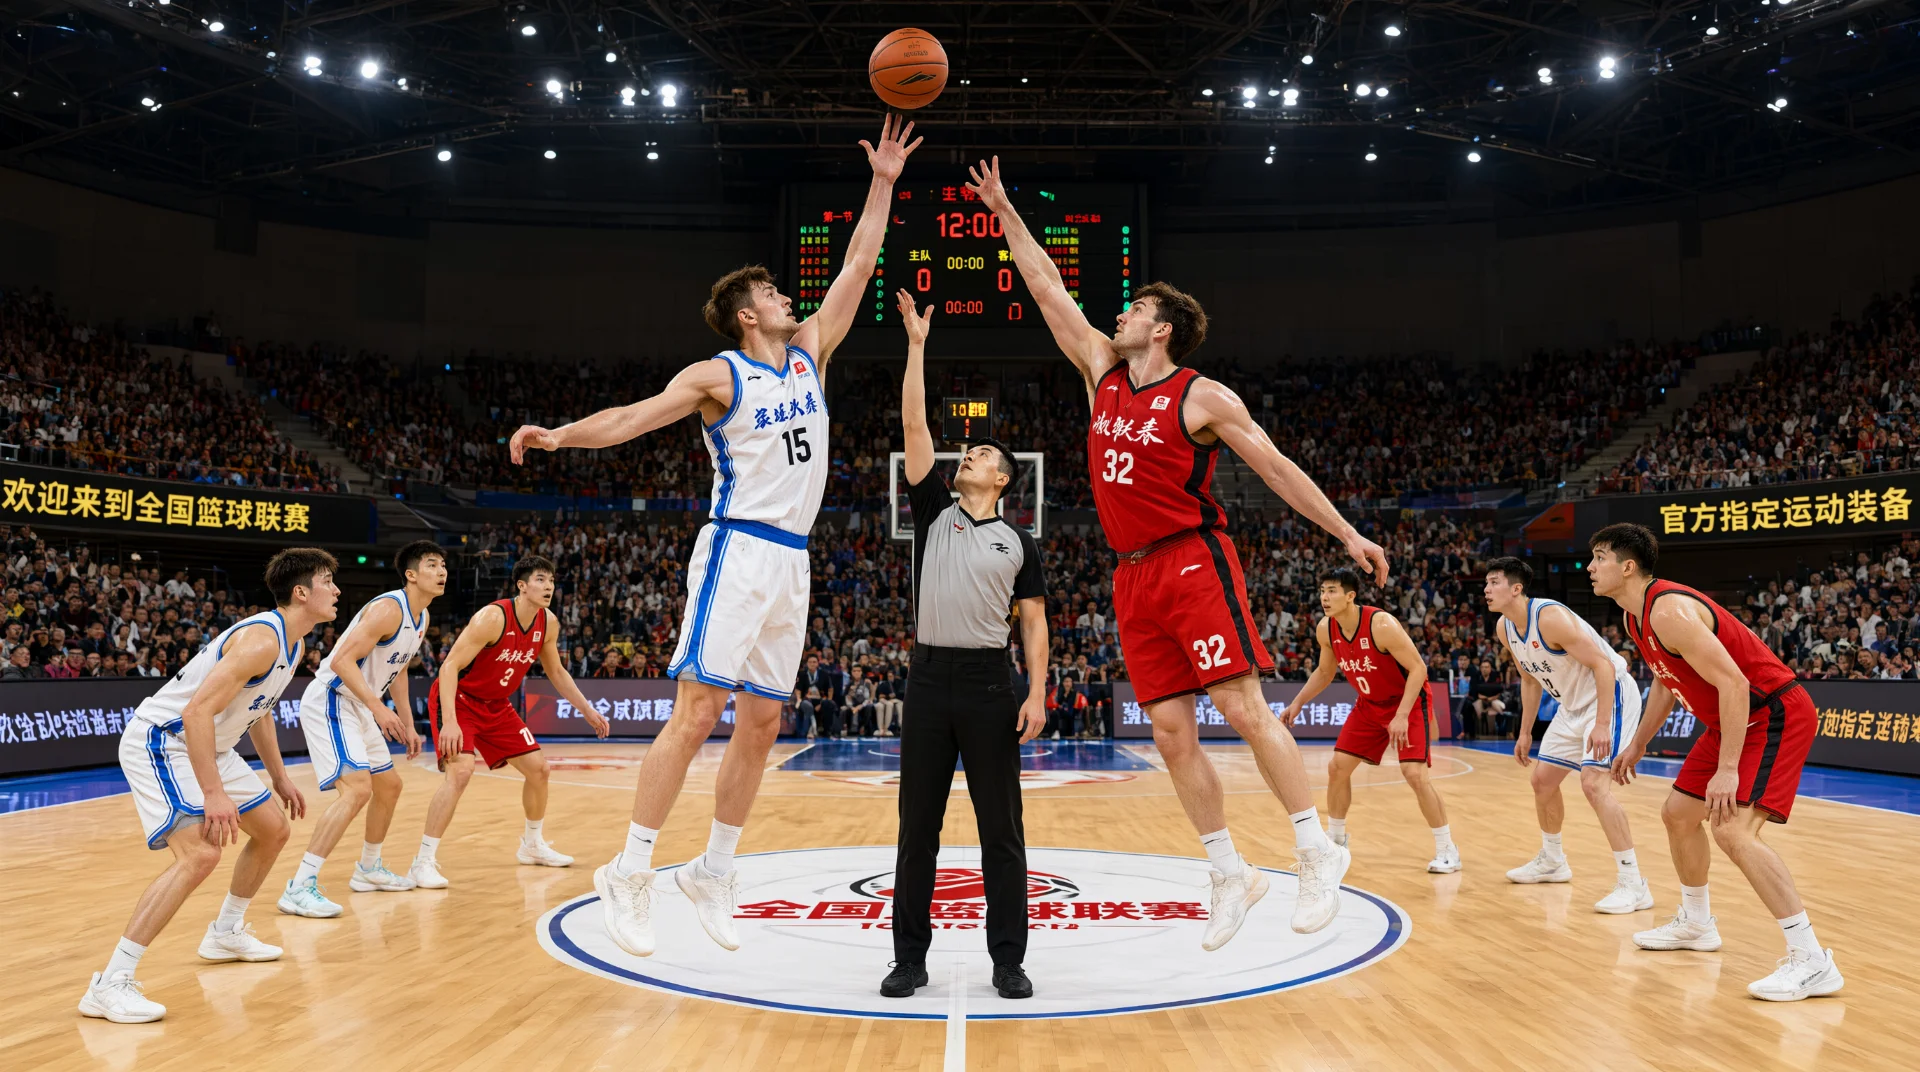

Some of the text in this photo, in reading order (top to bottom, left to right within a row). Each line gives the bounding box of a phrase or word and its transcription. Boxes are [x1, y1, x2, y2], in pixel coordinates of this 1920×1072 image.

[823, 211, 853, 222] 第一节
[936, 213, 1004, 238] 12:00
[909, 250, 931, 261] 主队
[947, 257, 984, 269] 00:00
[917, 268, 931, 291] 0
[998, 268, 1012, 291] 0
[946, 301, 983, 313] 00:00
[782, 427, 812, 465] 15
[1102, 449, 1134, 485] 32
[1, 478, 310, 533] 欢迎来到全国篮球联赛
[1660, 487, 1912, 534] 官方指定运动装备
[1193, 634, 1231, 670] 32
